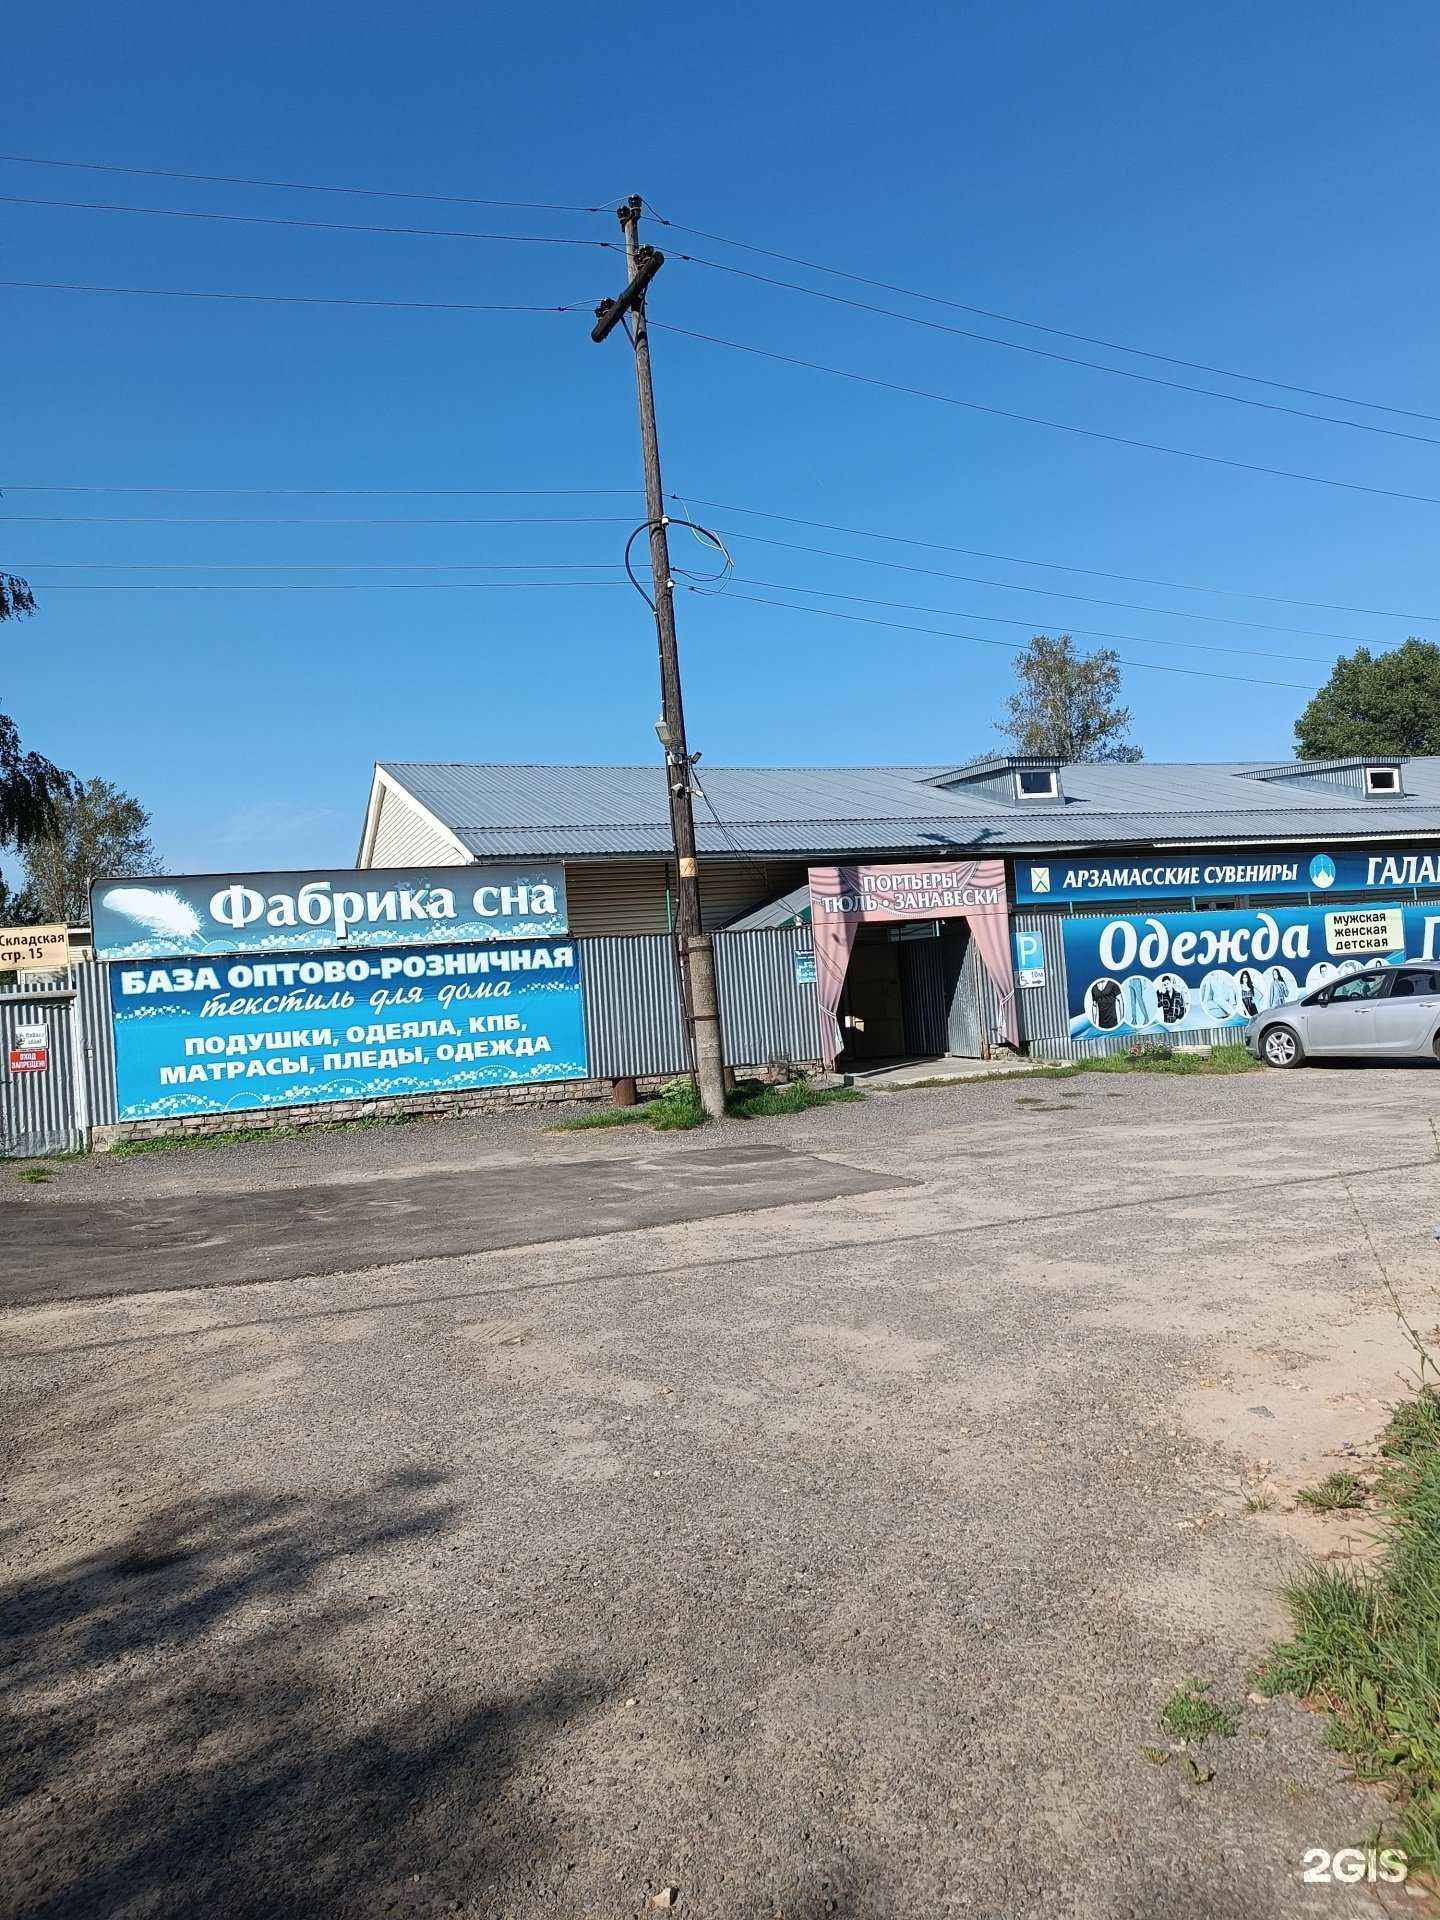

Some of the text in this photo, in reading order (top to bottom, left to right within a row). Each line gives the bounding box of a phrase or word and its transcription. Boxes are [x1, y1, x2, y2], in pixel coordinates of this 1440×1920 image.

[863, 872, 960, 892] ПОРТЬЕРЫ
[1063, 864, 1299, 888] АРЗАМАССКИЕ СУВЕНИРЫ
[1366, 856, 1440, 885] ГАЛА
[209, 882, 558, 939] Фабрика сна
[821, 888, 1000, 913] ТЮЛЬ ЗАНАВЕСКИ
[1333, 913, 1386, 926] мужская
[1334, 926, 1387, 937] женская
[0, 934, 65, 947] Складская
[1100, 912, 1310, 971] Одежда
[1336, 938, 1388, 950] детская
[1, 947, 43, 963] стр. 15
[121, 947, 574, 995] БАЗА ОПТОВО-РОЗНИЧНАЯ
[200, 981, 512, 1018] текстиль для дома
[185, 1013, 527, 1056] ПОДУШКИ, ОДЕЯЛА, КПБ,
[160, 1036, 552, 1085] МАТРАСЫ, ПЛЕДЫ, ОДЕЖДА
